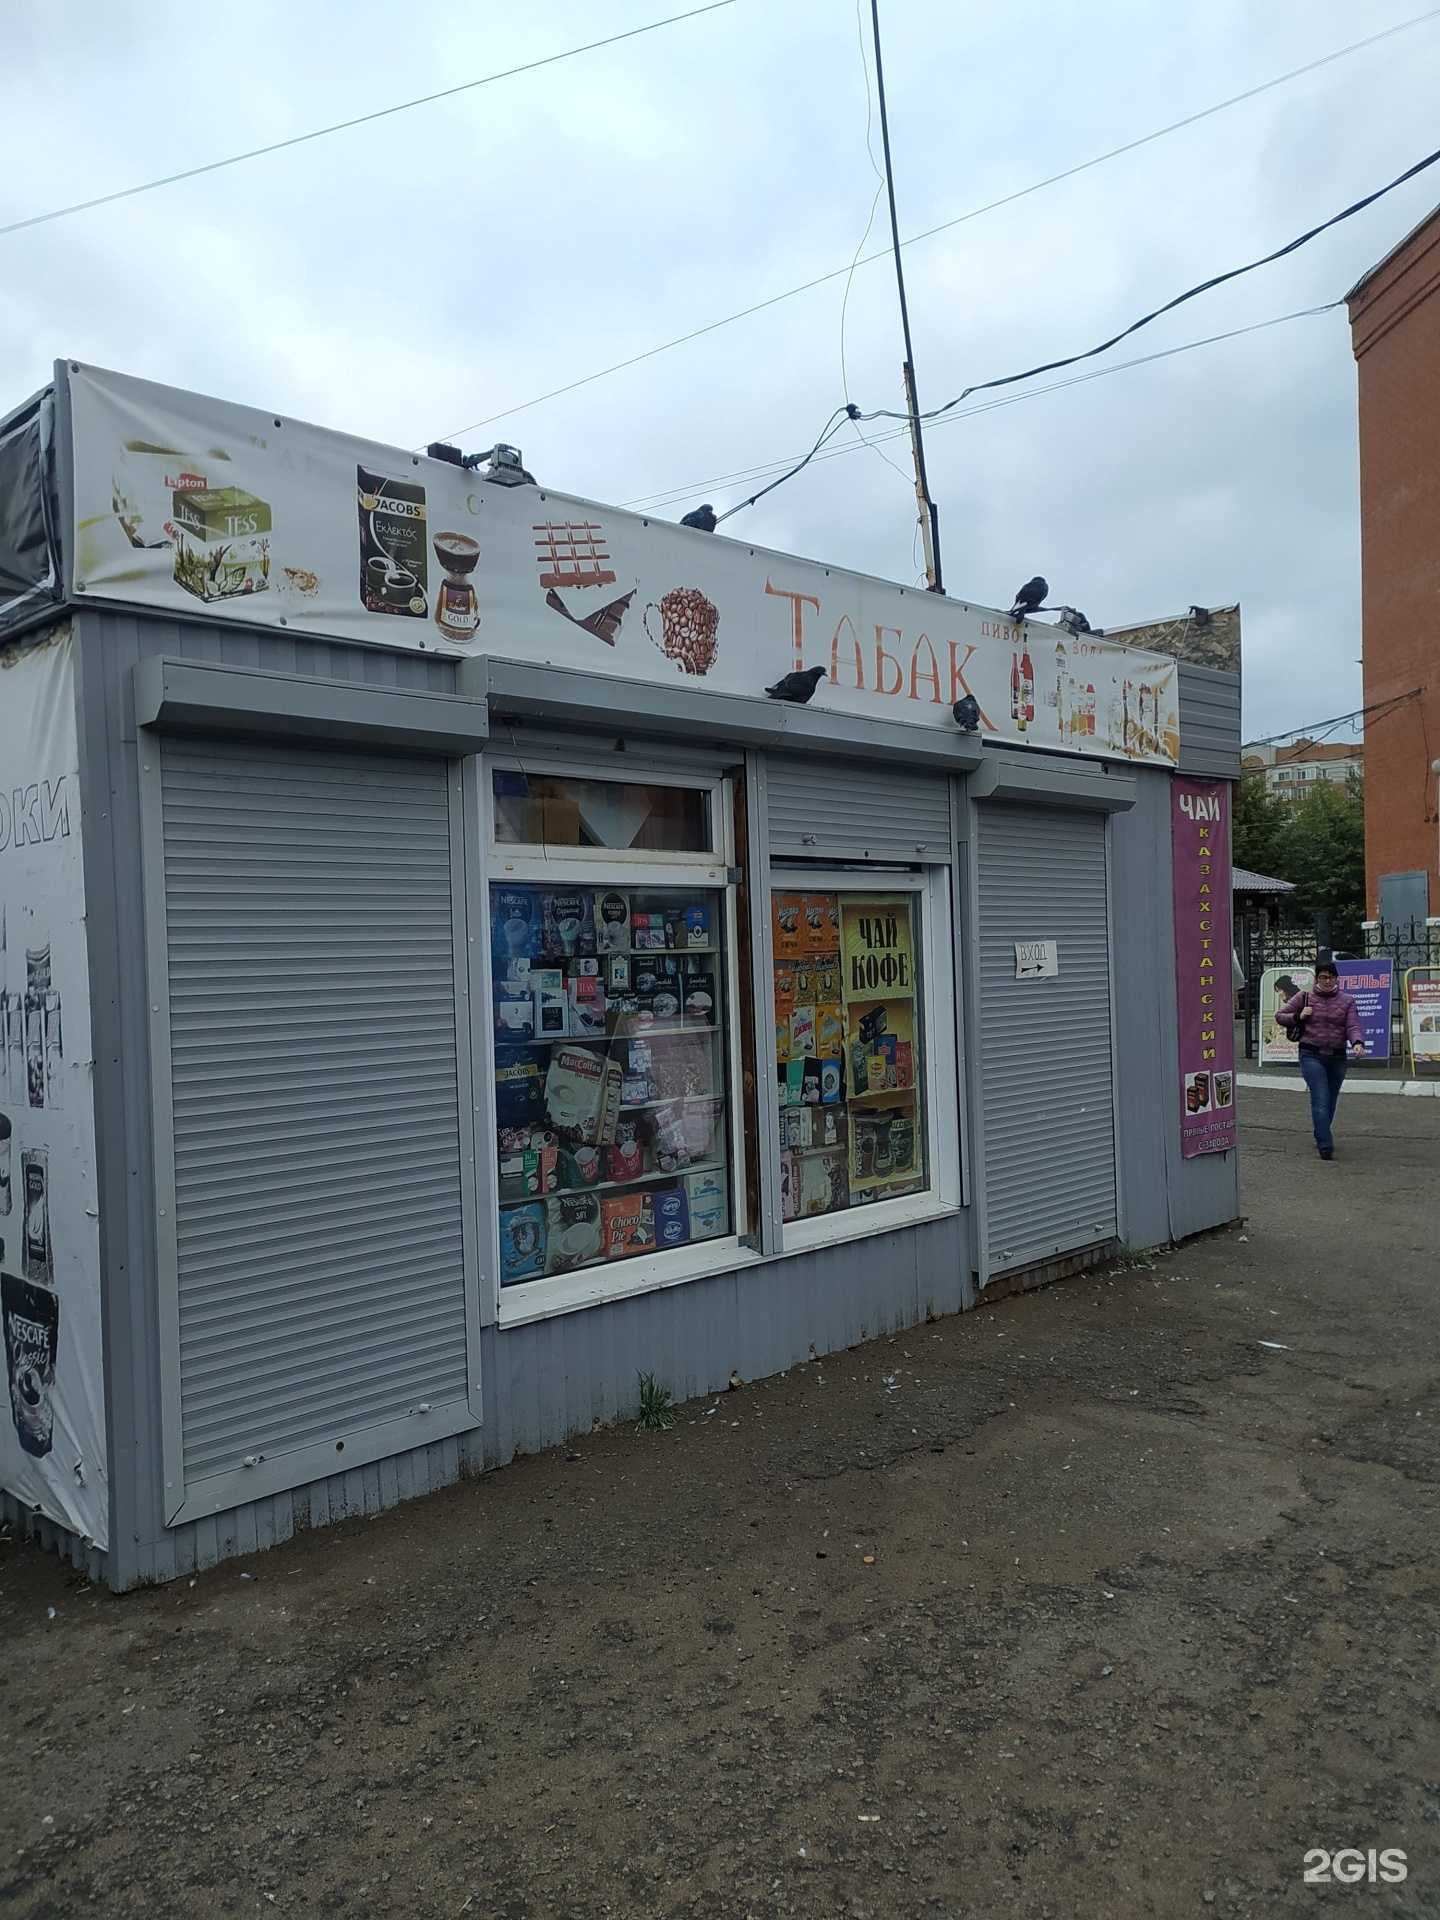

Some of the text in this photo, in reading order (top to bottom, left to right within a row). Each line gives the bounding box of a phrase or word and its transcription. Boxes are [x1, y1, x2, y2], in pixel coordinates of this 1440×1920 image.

[167, 475, 205, 488] Lipton
[374, 498, 421, 516] JACOBS
[224, 513, 257, 536] TESS
[981, 621, 1019, 643] ПИВО
[764, 576, 999, 732] ТАБАК
[1179, 791, 1220, 821] ЧАЙ
[859, 913, 898, 949] ЧАЙ
[1021, 943, 1049, 961] ВХОД
[852, 953, 909, 990] КОФЕ
[1337, 974, 1390, 991] ТЕЛЬЕ
[610, 1214, 640, 1231] Choco
